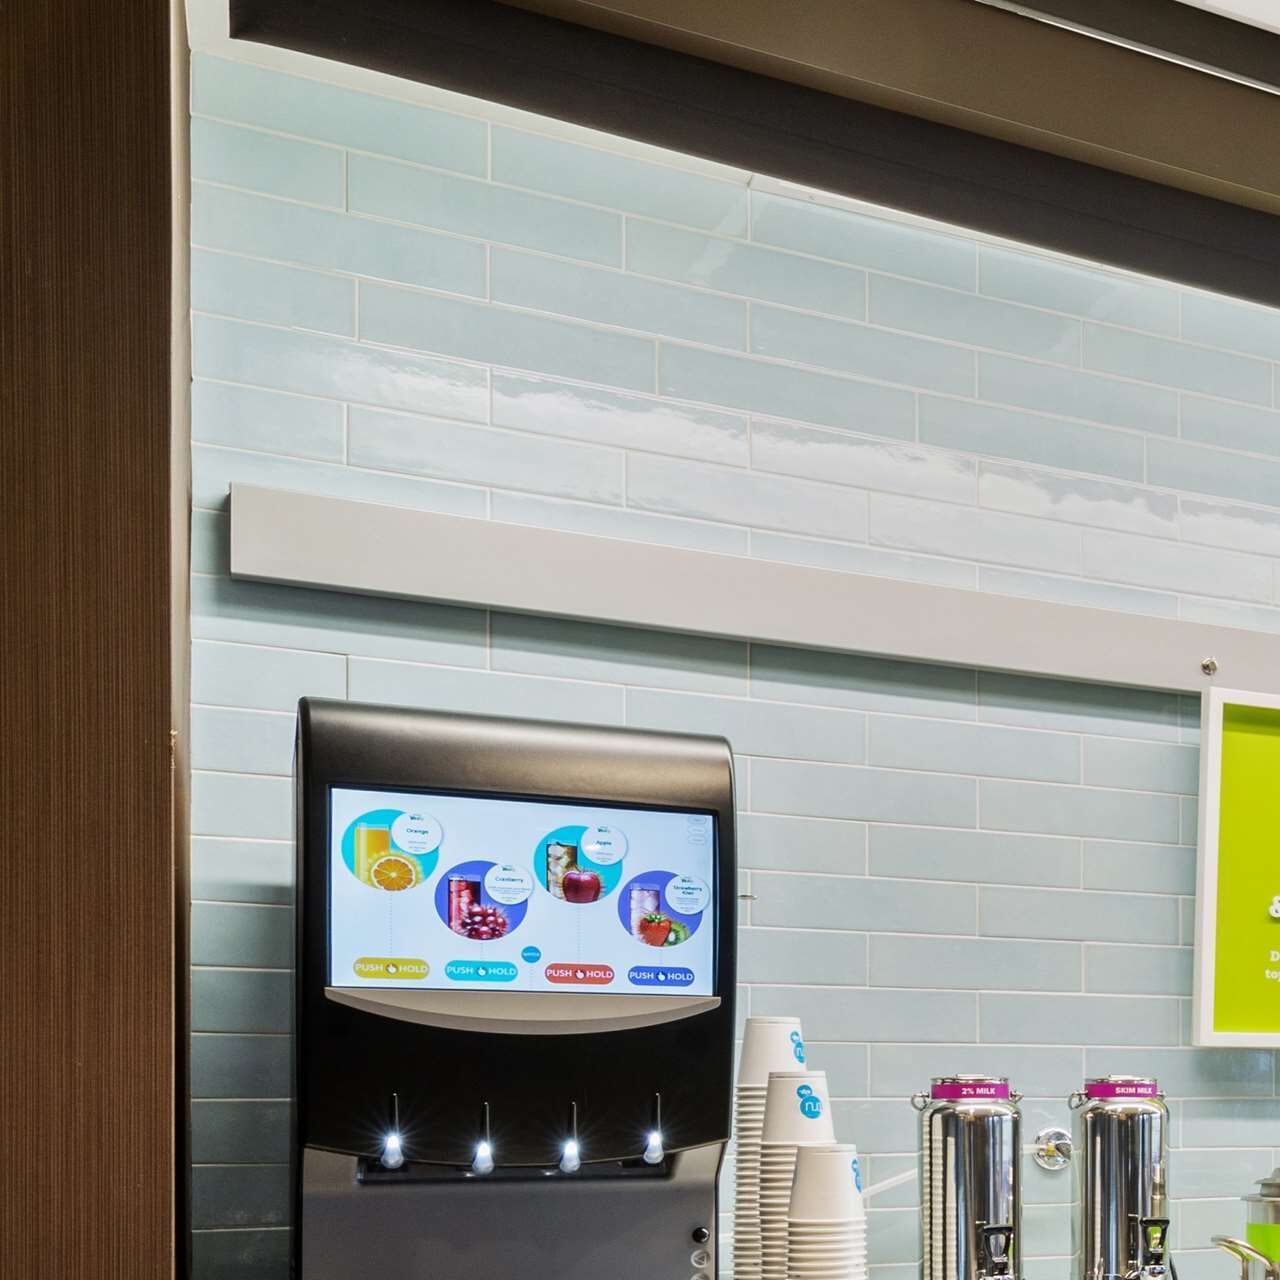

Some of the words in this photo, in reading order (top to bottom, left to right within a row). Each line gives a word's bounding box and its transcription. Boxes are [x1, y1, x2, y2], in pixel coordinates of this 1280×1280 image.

[355, 962, 384, 973] PUSH
[400, 964, 429, 974] HOLD
[447, 966, 473, 976] PUSH
[488, 967, 517, 977] HOLD
[546, 968, 573, 978] PUSH
[586, 970, 614, 979] HOLD
[629, 971, 655, 980] PUSH
[667, 973, 694, 982] HOLD
[961, 1087, 974, 1095] 2%
[976, 1087, 996, 1095] MILK
[1115, 1087, 1135, 1095] SKIM
